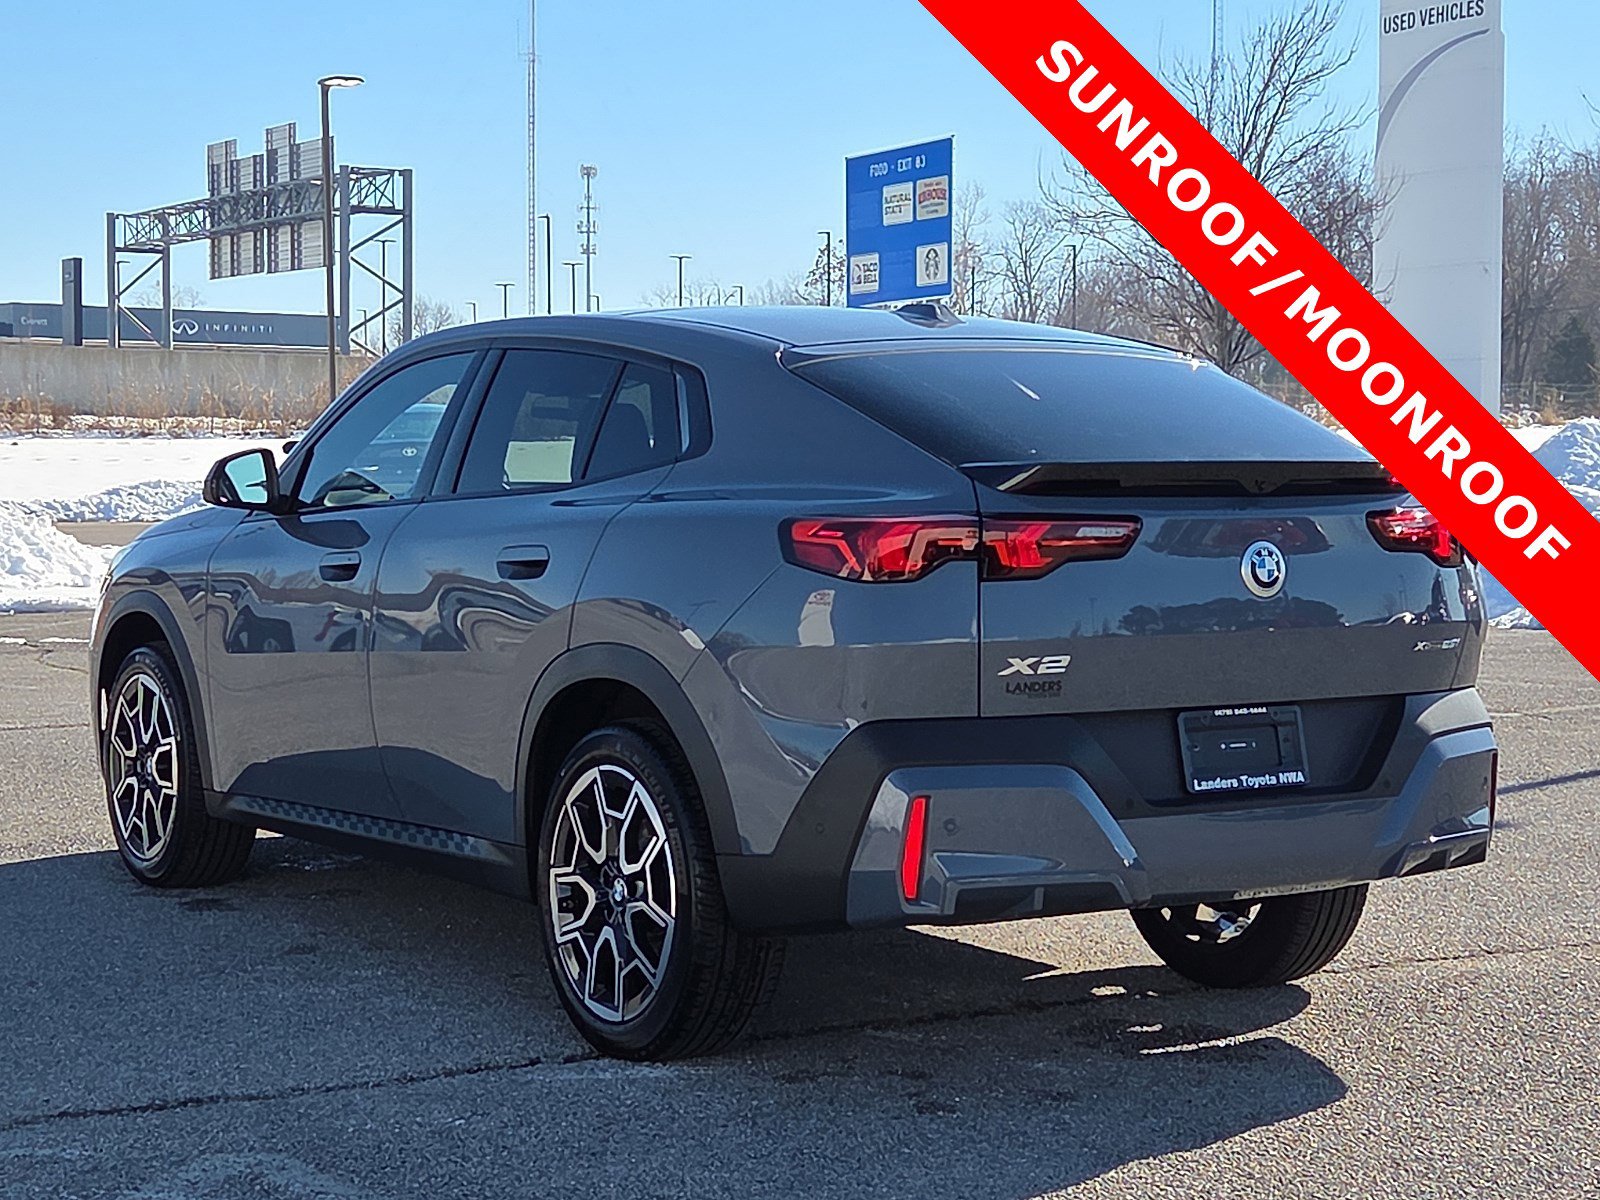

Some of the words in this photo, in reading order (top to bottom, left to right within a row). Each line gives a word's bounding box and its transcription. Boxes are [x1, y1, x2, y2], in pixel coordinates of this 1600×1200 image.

[1383, 11, 1415, 34] USED
[1419, 0, 1485, 27] VEHICLES
[869, 162, 889, 177] FOOD
[897, 157, 912, 172] EXIT
[884, 192, 912, 205] NATURAL
[884, 205, 903, 216] STATE
[205, 323, 274, 334] INFINITI
[997, 655, 1072, 676] X2
[1005, 680, 1063, 694] LANDERS
[1193, 777, 1239, 791] Landers
[1240, 773, 1278, 788] Toyota
[1279, 771, 1306, 784] NWA
